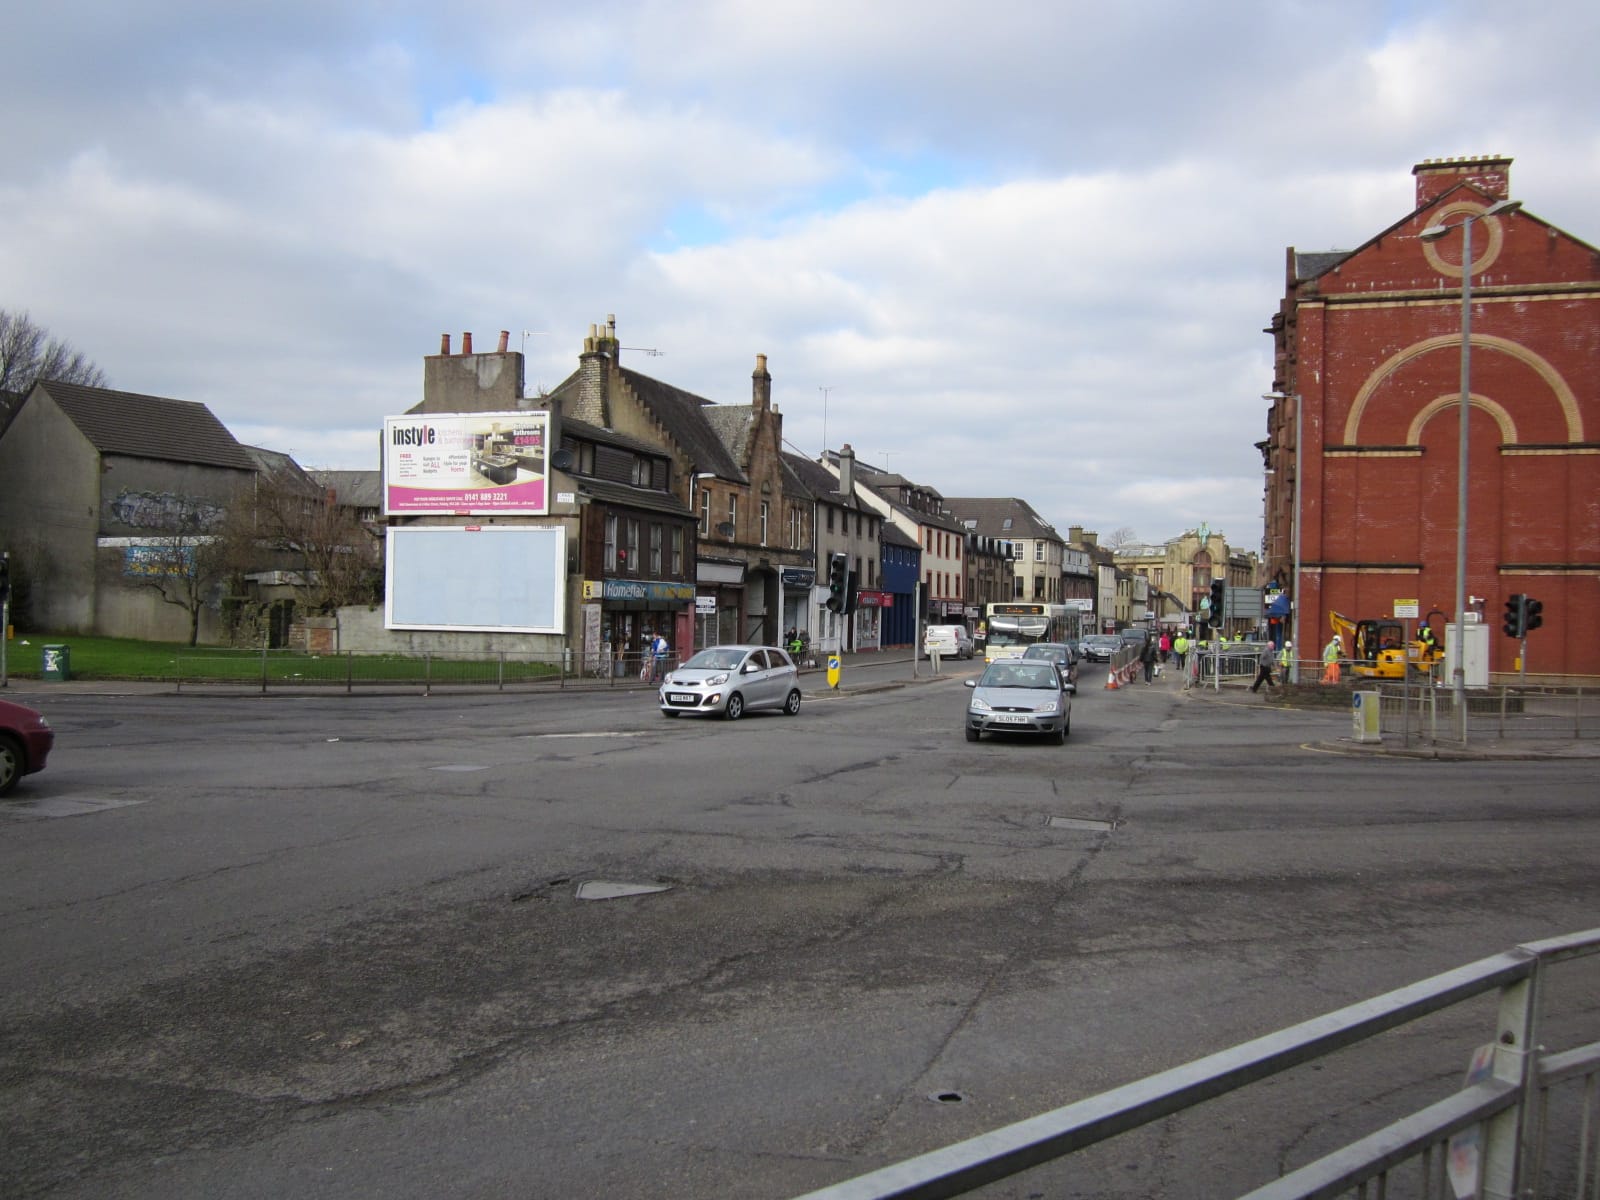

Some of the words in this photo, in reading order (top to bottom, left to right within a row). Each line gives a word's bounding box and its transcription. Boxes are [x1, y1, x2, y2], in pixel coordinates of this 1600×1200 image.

[393, 425, 435, 446] instyle
[514, 435, 540, 445] £1495
[465, 493, 479, 501] 0141
[493, 492, 508, 500] 3221
